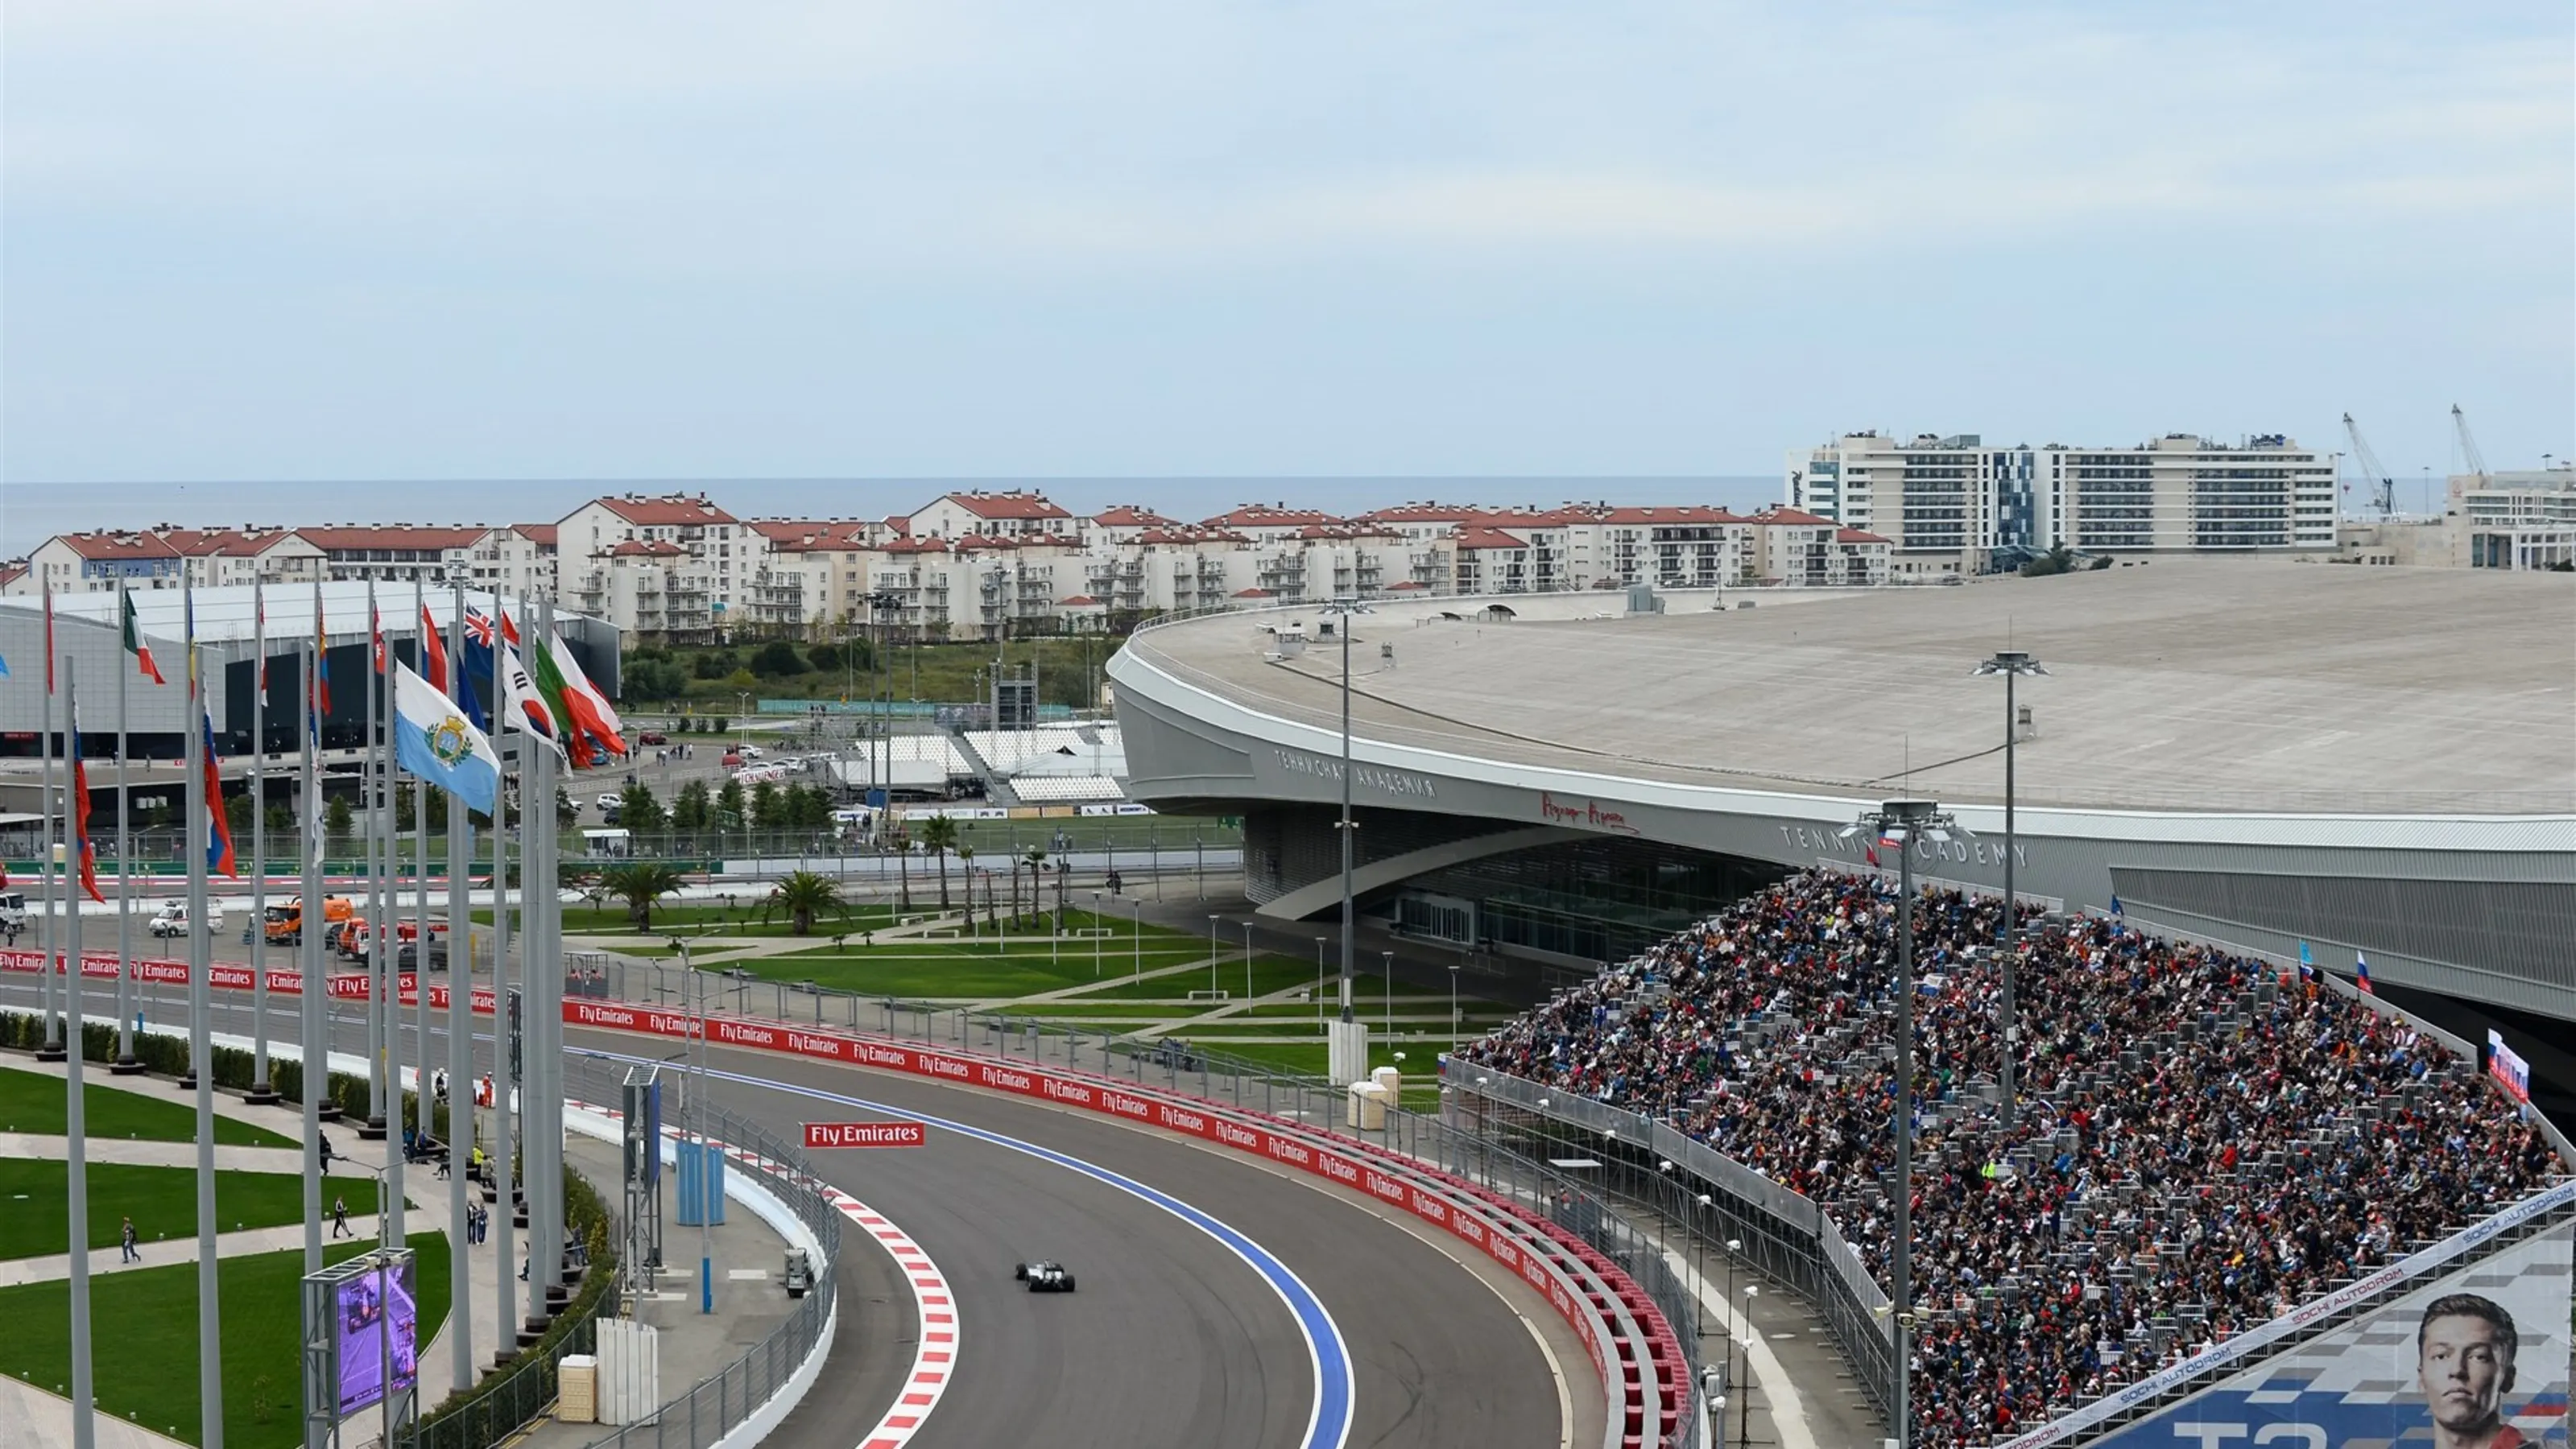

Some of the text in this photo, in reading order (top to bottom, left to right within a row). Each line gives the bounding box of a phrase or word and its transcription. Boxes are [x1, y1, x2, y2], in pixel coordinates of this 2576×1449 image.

[1357, 767, 1437, 798] АКАДЕМИЯ
[1917, 838, 2026, 867] CADEMY
[81, 959, 121, 973] Emirate
[146, 964, 186, 980] Emirates
[209, 969, 250, 985] Emirates
[272, 974, 303, 989] Emirat
[338, 979, 358, 994] Fly
[580, 1005, 634, 1026] Fly Emirates
[651, 1015, 666, 1032] Fly
[720, 1024, 773, 1044] Fly Emirates
[788, 1034, 838, 1055] Fly Emirates
[854, 1043, 905, 1066] Fly Emirates
[919, 1055, 968, 1077] Fly Emirates
[982, 1067, 1030, 1090] Fly Emirates
[1044, 1079, 1090, 1102] Fly Emirates
[1102, 1092, 1147, 1117] Fly Emirates
[1161, 1106, 1203, 1131] Fly Emirates
[811, 1125, 918, 1145] Fly Emirates
[1216, 1121, 1256, 1147] Fly Emirates
[1268, 1137, 1309, 1164] Fly Emirates
[1319, 1153, 1357, 1182] Fly Emirates
[1367, 1172, 1404, 1201] Fly Emirates
[2462, 1187, 2574, 1244] SOCHI AUTODROM
[2292, 1268, 2404, 1325] SOCHI AUTODROM
[2119, 1347, 2232, 1405] SOCHI AUTODROM
